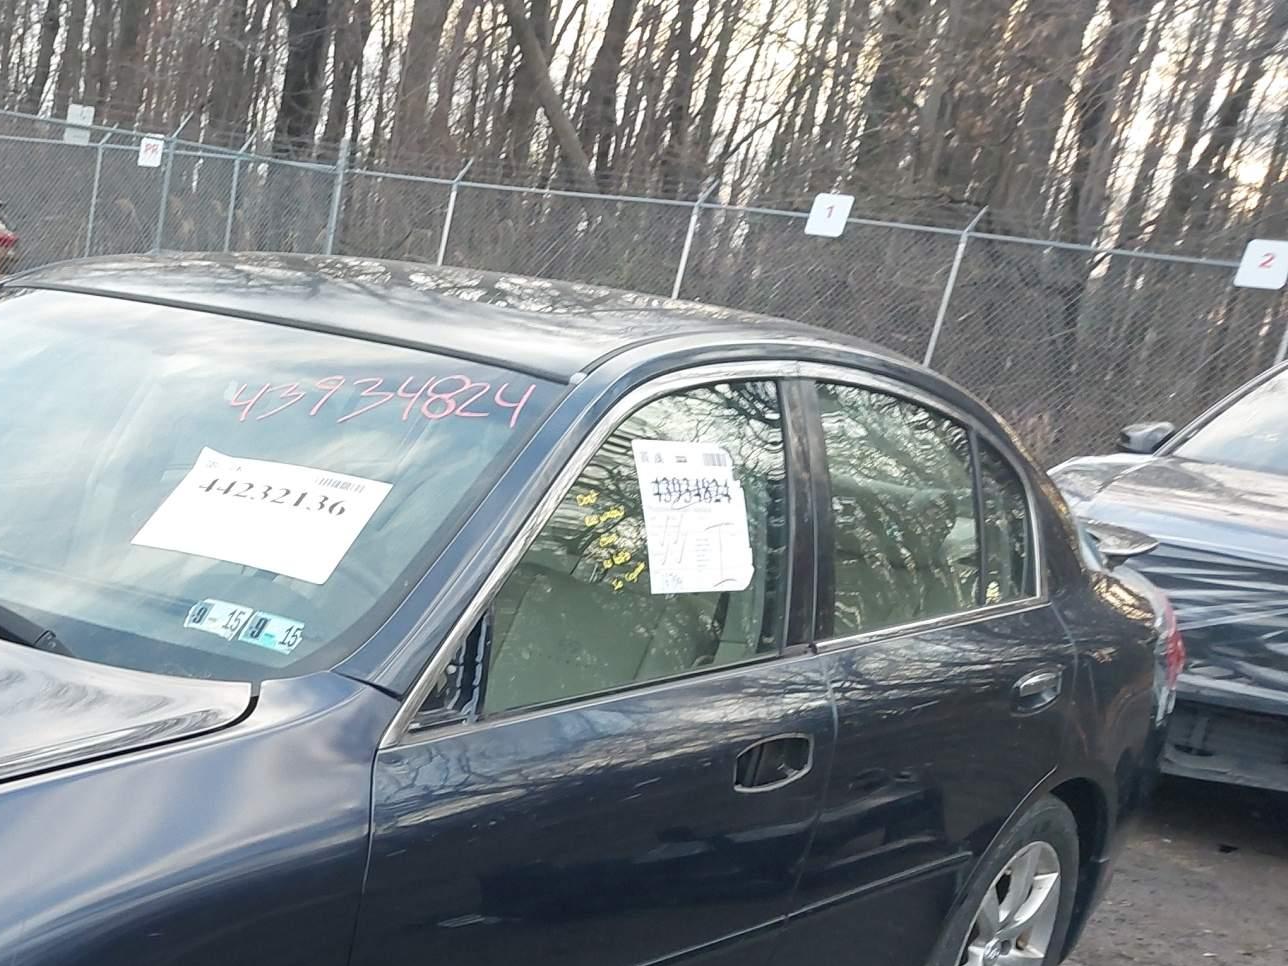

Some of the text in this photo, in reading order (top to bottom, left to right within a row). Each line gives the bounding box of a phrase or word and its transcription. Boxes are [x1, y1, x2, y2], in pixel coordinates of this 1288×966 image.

[826, 205, 835, 219] 1
[1258, 252, 1276, 269] 2
[231, 374, 537, 428] 43934824
[198, 478, 346, 516] 44232136
[221, 608, 246, 632] 15
[278, 624, 303, 647] 15
